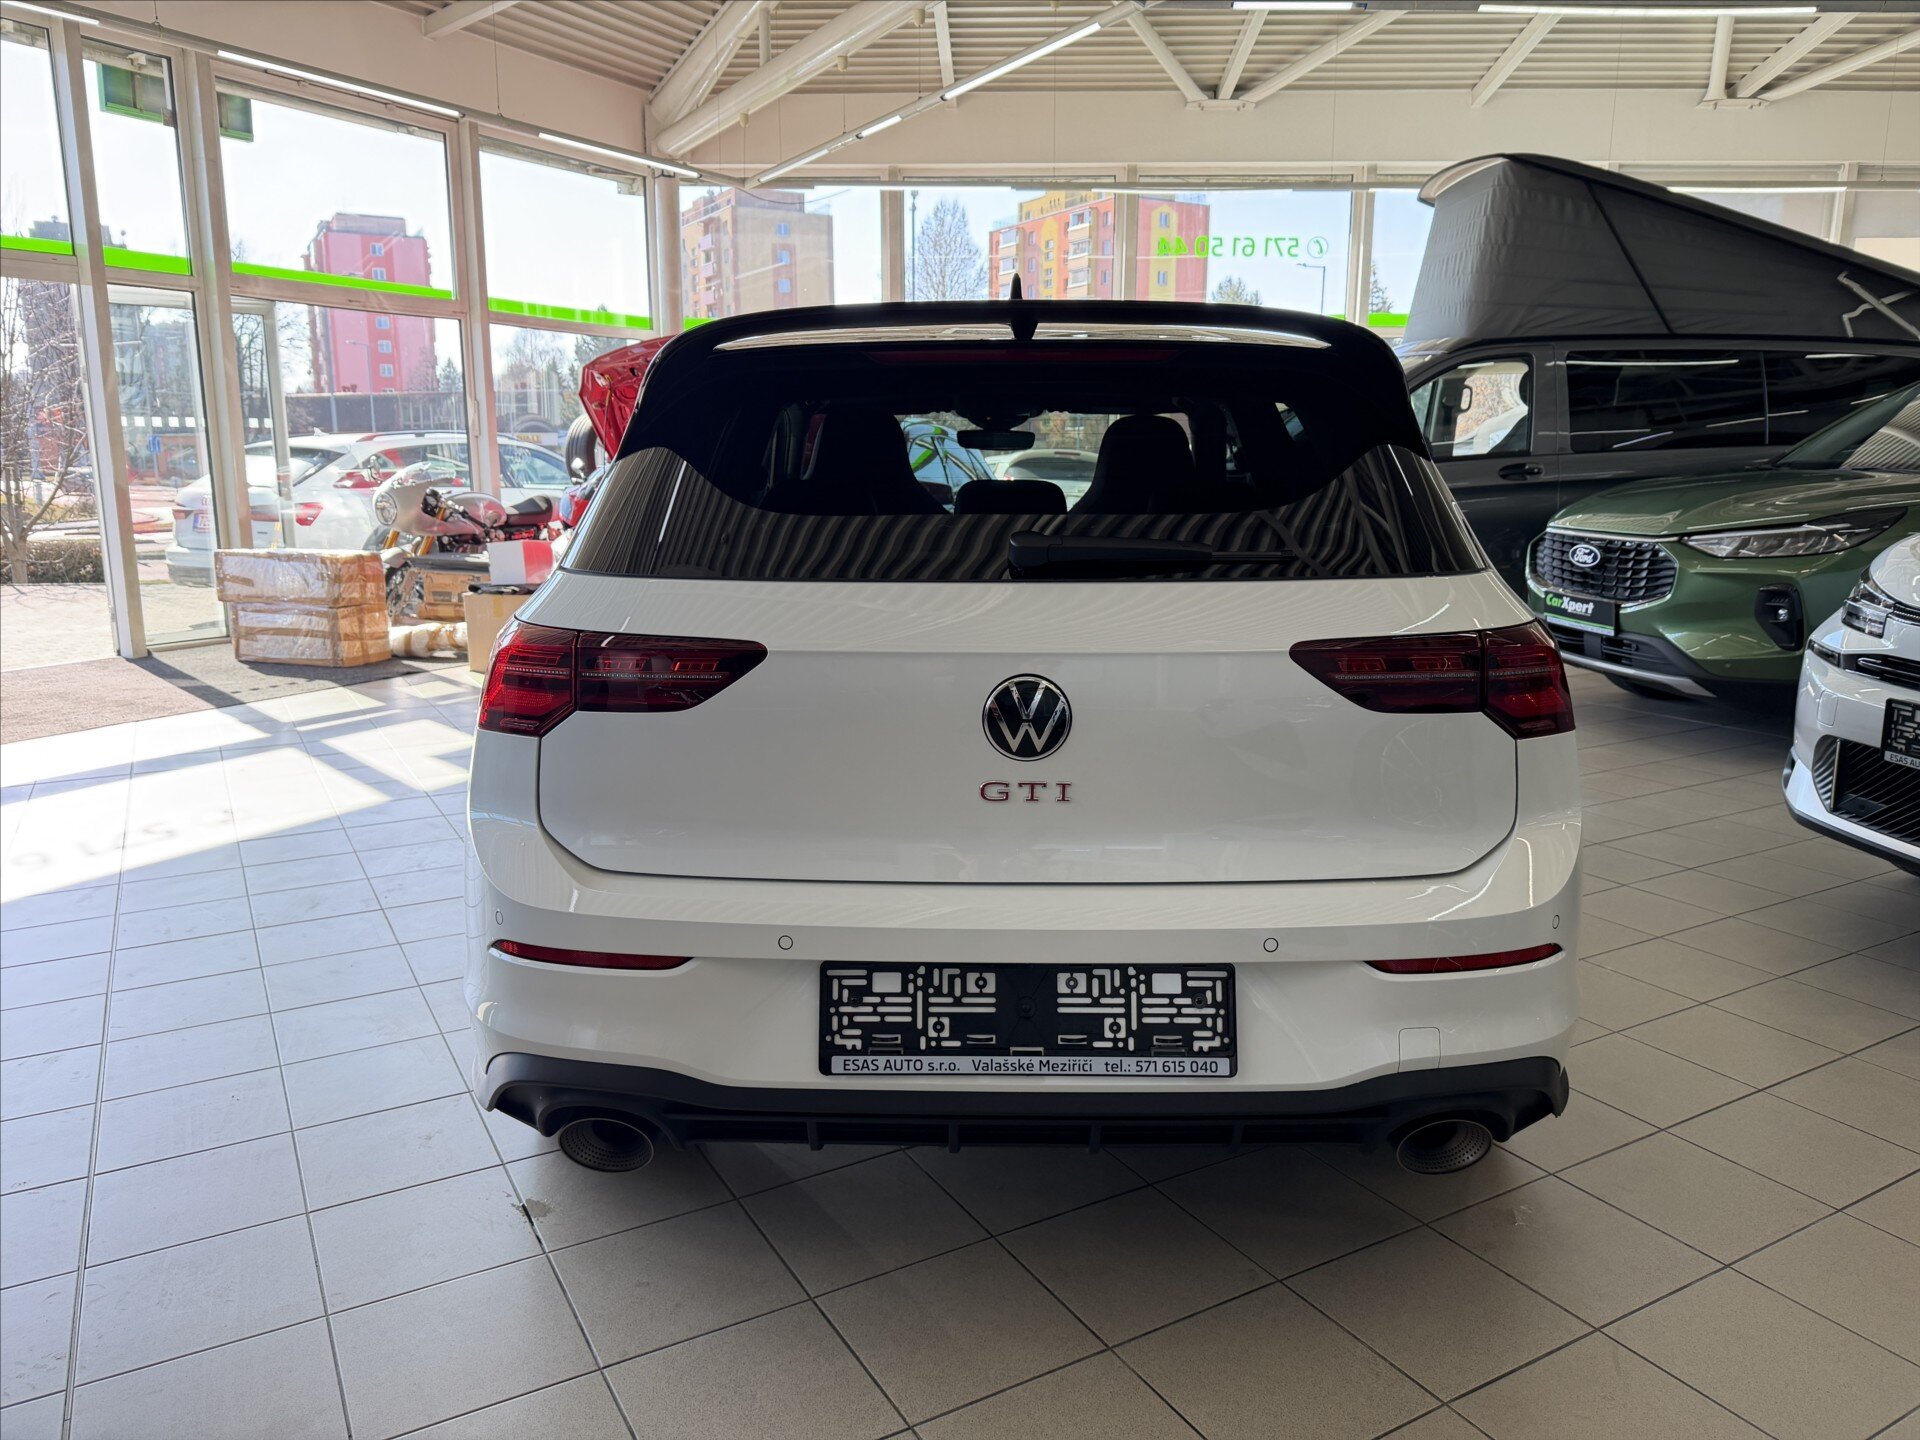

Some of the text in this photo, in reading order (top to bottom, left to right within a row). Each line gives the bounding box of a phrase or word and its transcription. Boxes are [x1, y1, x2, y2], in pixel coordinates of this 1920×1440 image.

[1545, 594, 1594, 614] CarXpert
[1889, 753, 1908, 765] ESAS
[980, 781, 1072, 802] GTI
[843, 1058, 1218, 1074] ESAS AUTO s.r.o. Valašské Meziříčí tel.: 571 615 040
